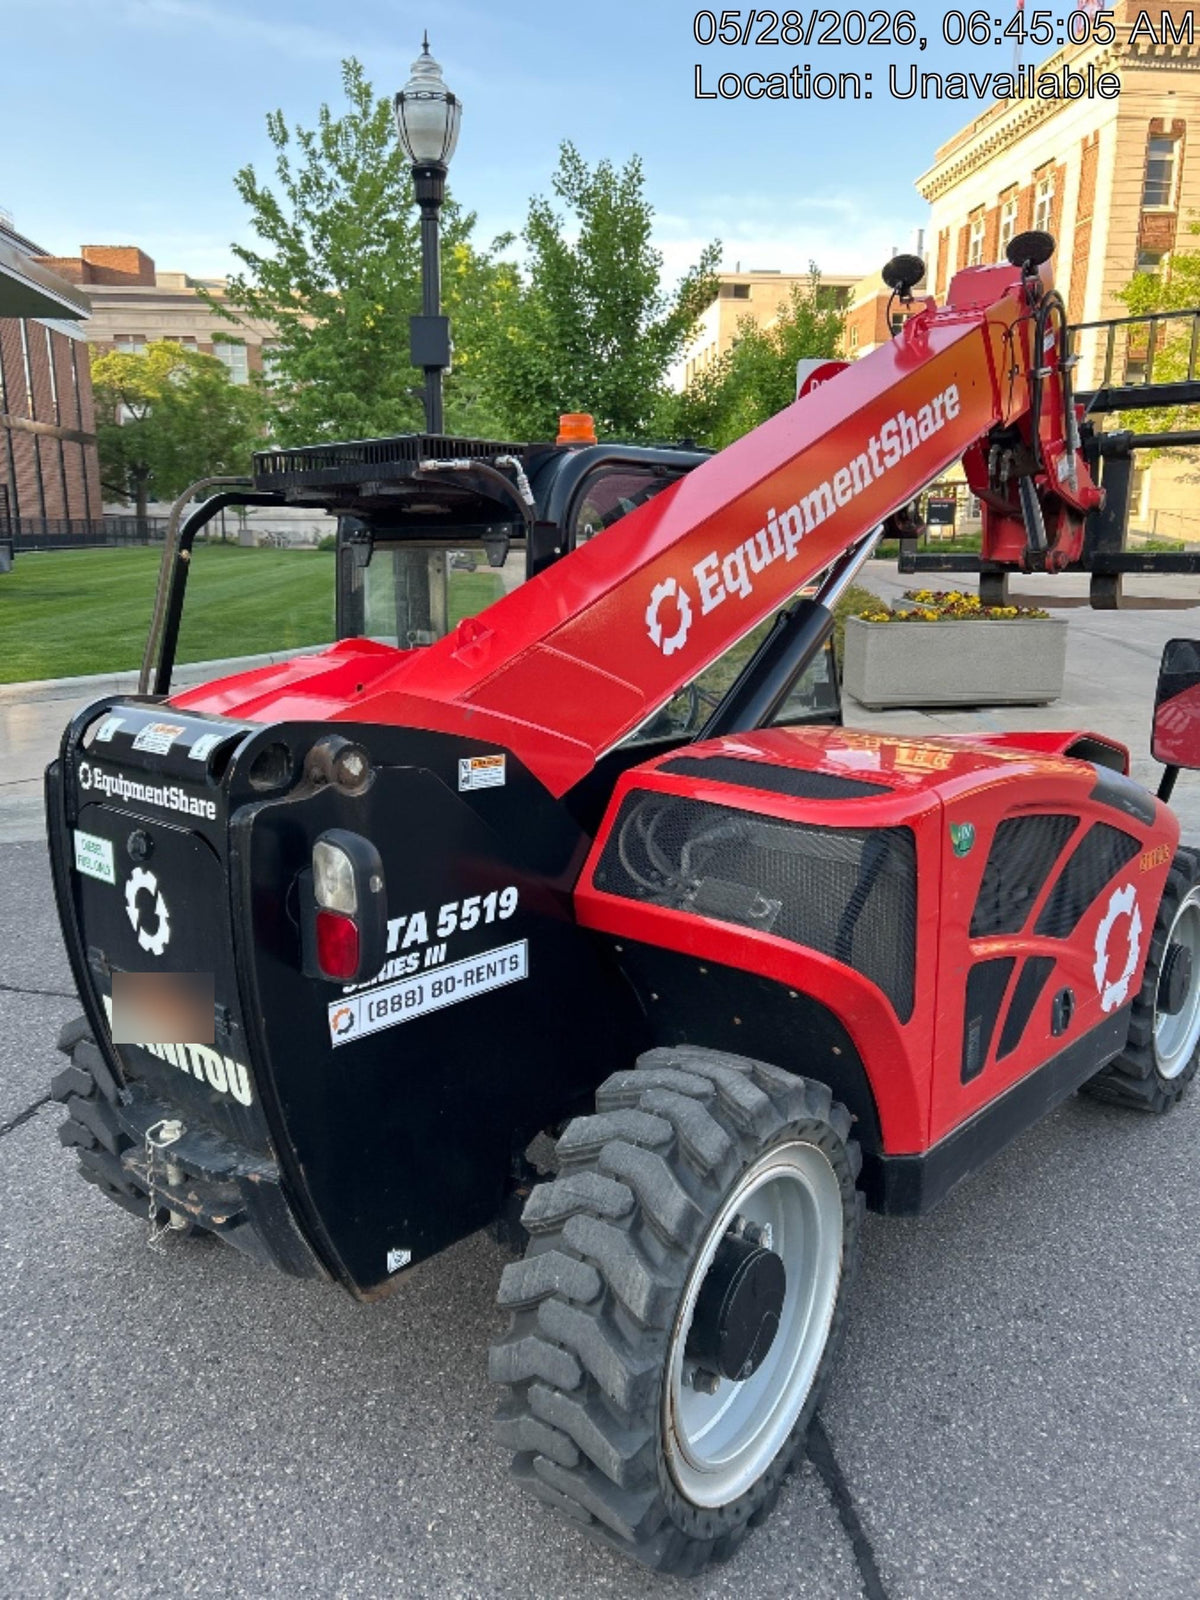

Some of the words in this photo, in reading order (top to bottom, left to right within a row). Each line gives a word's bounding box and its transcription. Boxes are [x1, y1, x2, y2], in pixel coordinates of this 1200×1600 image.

[692, 382, 962, 616] EquipmentShare
[93, 767, 217, 821] EquipmentShare
[437, 885, 519, 938] 5519
[343, 949, 420, 994] RIES
[424, 943, 448, 967] III
[367, 985, 424, 1023] (888)
[431, 953, 520, 998] 80-RENTS
